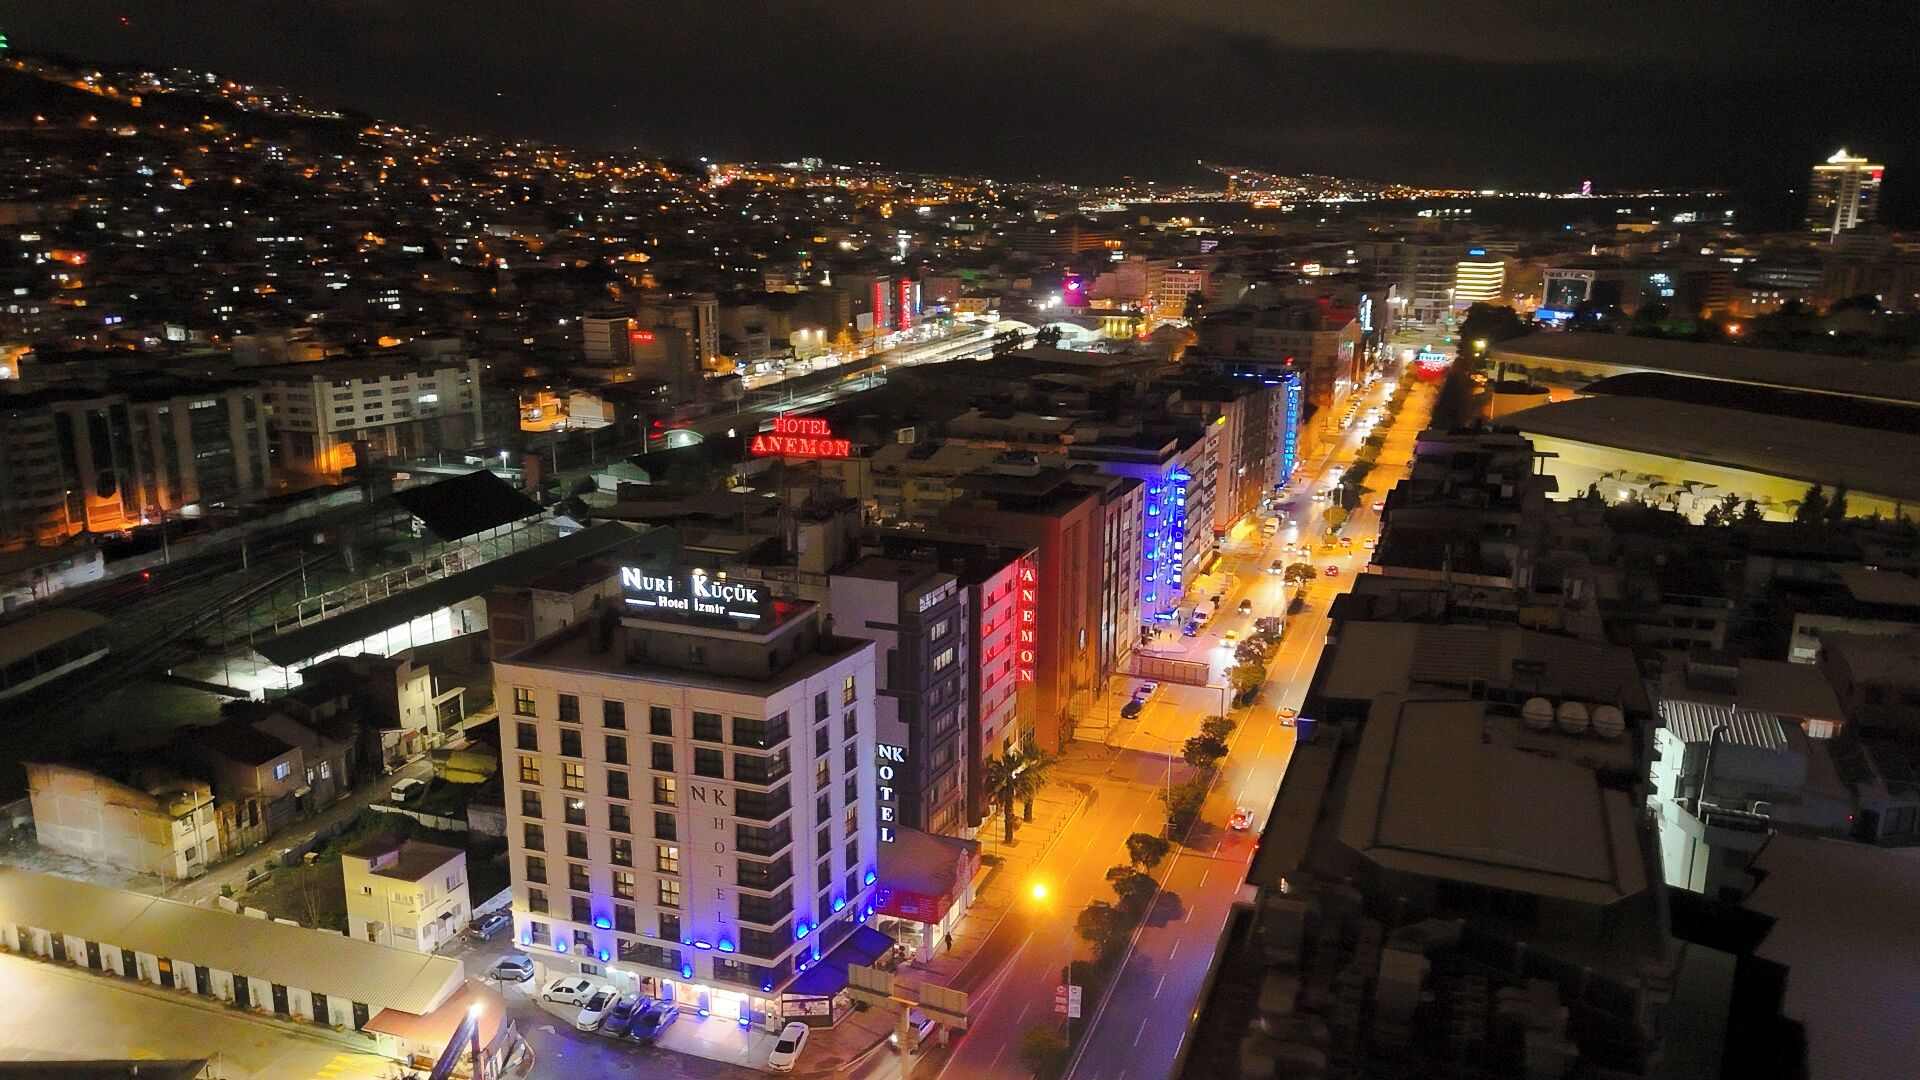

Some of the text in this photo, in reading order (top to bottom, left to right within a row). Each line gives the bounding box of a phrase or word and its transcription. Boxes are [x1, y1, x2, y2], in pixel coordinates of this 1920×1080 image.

[752, 436, 850, 456] ANEMON
[775, 418, 831, 435] HOTEL
[1173, 487, 1186, 583] RESIDENCE
[658, 595, 689, 610] Hotel
[1022, 570, 1034, 681] ANEMON
[878, 744, 905, 762] NK
[879, 766, 894, 843] OTEL
[714, 817, 727, 924] HOTEL
